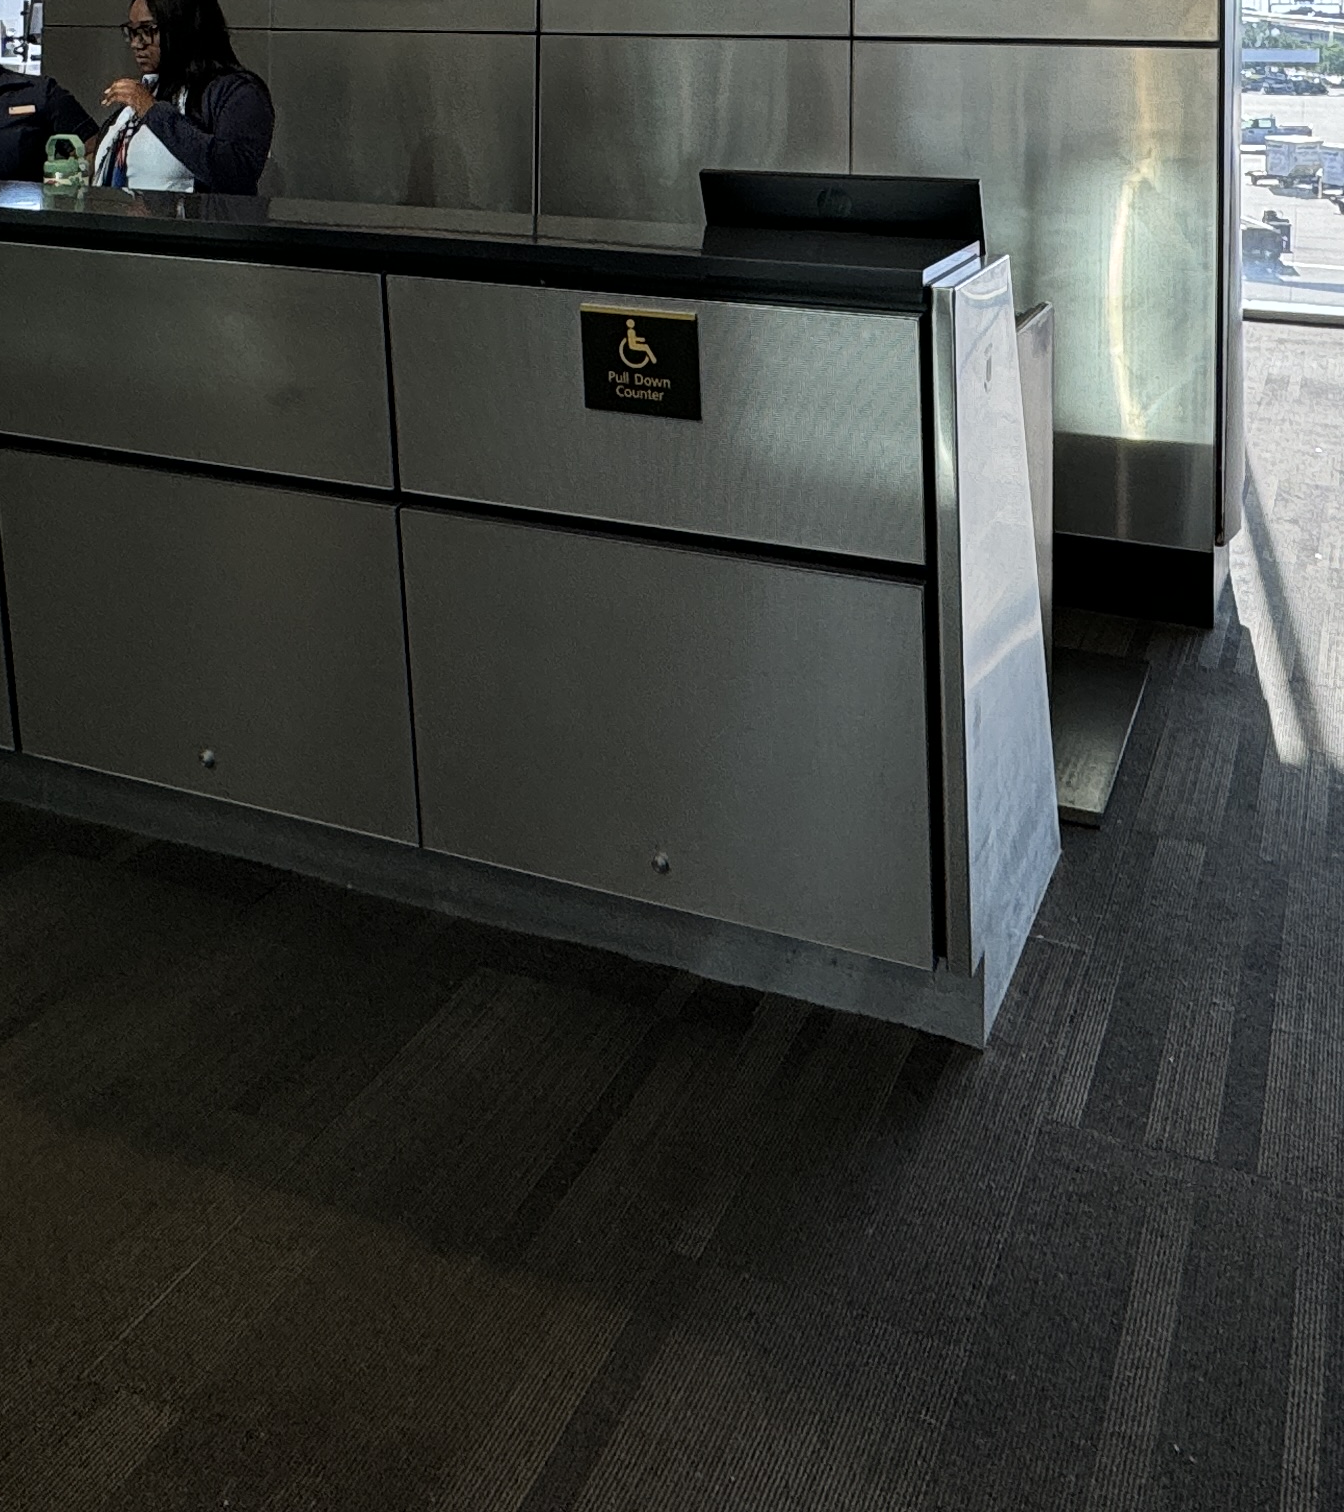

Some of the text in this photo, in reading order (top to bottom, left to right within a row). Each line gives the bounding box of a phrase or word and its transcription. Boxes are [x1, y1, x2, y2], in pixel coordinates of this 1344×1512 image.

[608, 370, 671, 389] Pull Down
[615, 385, 664, 401] Counter
